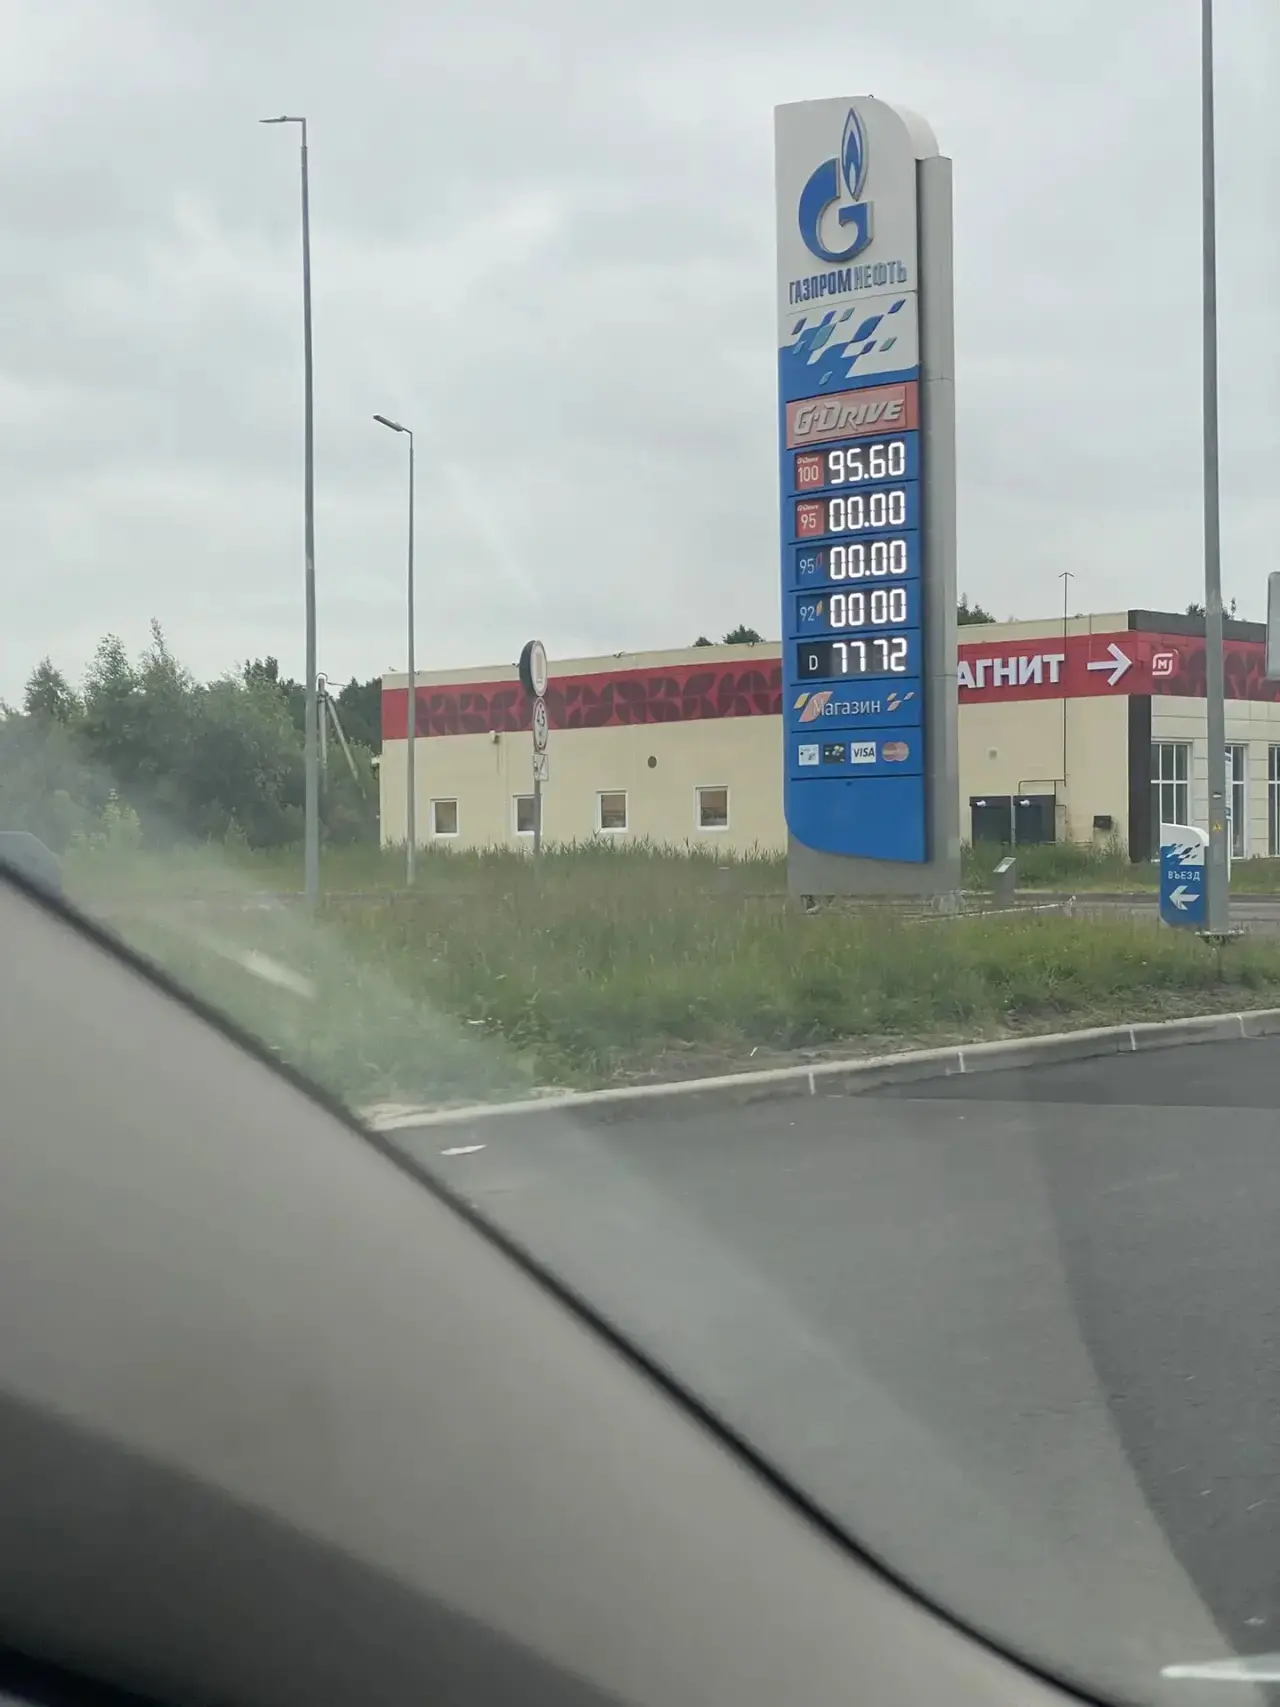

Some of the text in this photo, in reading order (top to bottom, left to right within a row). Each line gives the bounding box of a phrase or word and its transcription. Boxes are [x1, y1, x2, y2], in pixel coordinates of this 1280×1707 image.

[788, 260, 908, 305] ГАЗПРОМНЕФТЬ
[797, 441, 905, 484] 100 95.60
[800, 490, 906, 531] 95 00.00
[799, 540, 907, 580] 95 00.00
[799, 606, 815, 622] 92
[808, 655, 819, 671] D
[813, 699, 881, 717] Магазин
[853, 747, 876, 758] VISA
[1167, 870, 1201, 881] ВЪЕЗД
